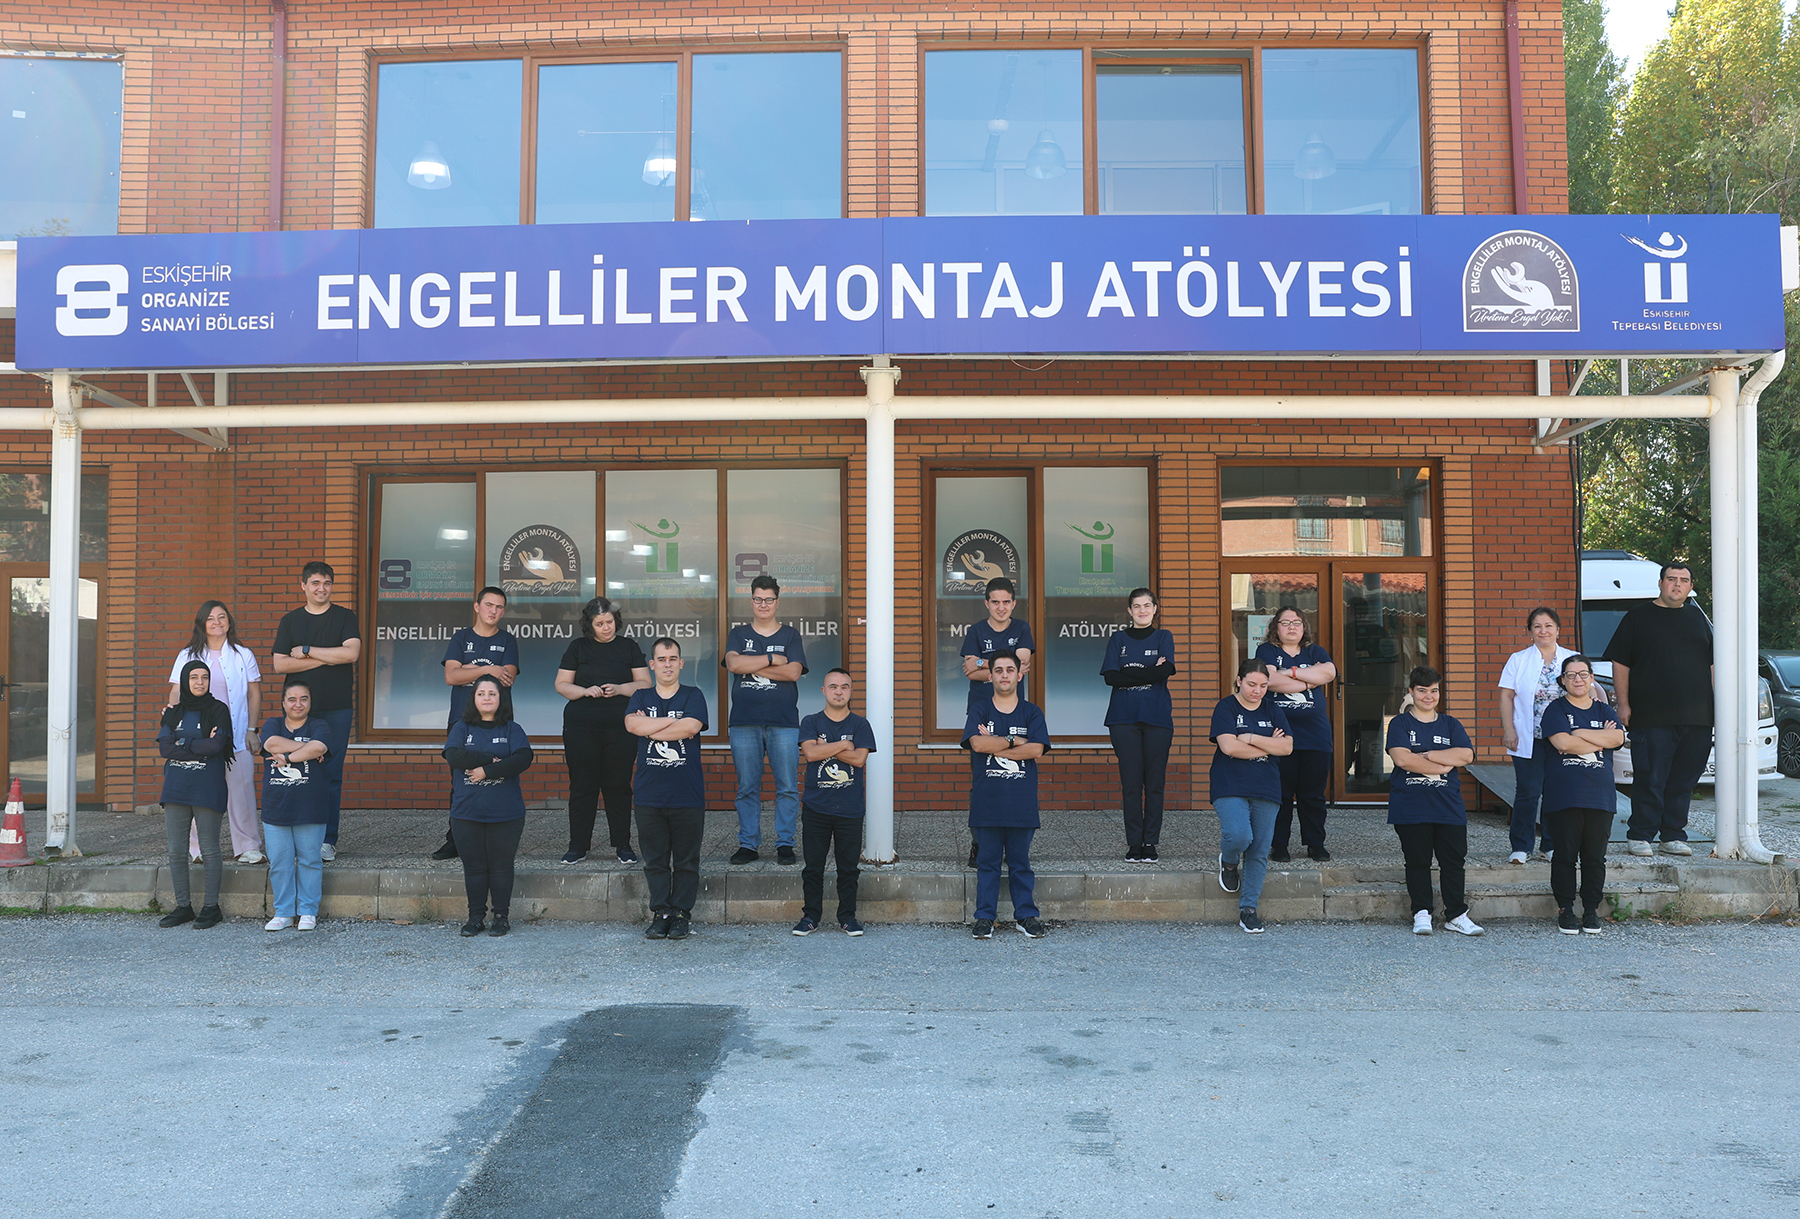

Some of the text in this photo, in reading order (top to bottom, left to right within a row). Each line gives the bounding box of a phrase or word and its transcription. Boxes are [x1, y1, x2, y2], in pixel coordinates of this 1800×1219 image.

[142, 262, 232, 286] ESKİŞEHİR
[1470, 236, 1572, 295] ENGELLİLER MONTAJ ATÖLYESİ
[141, 288, 230, 308] ORGANİZE
[317, 246, 1412, 330] ENGELLİLER MONTAJ ATÖLYESİ
[141, 312, 274, 332] SANAYİ BÖLGESİ
[1470, 309, 1509, 323] Üretene
[1510, 310, 1540, 327] Engel
[1664, 320, 1722, 331] BELEDİYESİ
[503, 528, 577, 572] ENGELLİLER MONTAJ ATÖLYESİ
[946, 532, 1017, 573] ENGELLİLER MONTAJ ATÖLYESİ
[773, 565, 815, 574] ORGANİZE
[506, 624, 573, 639] MONTAJ
[624, 620, 700, 638] ATÖLYESİ
